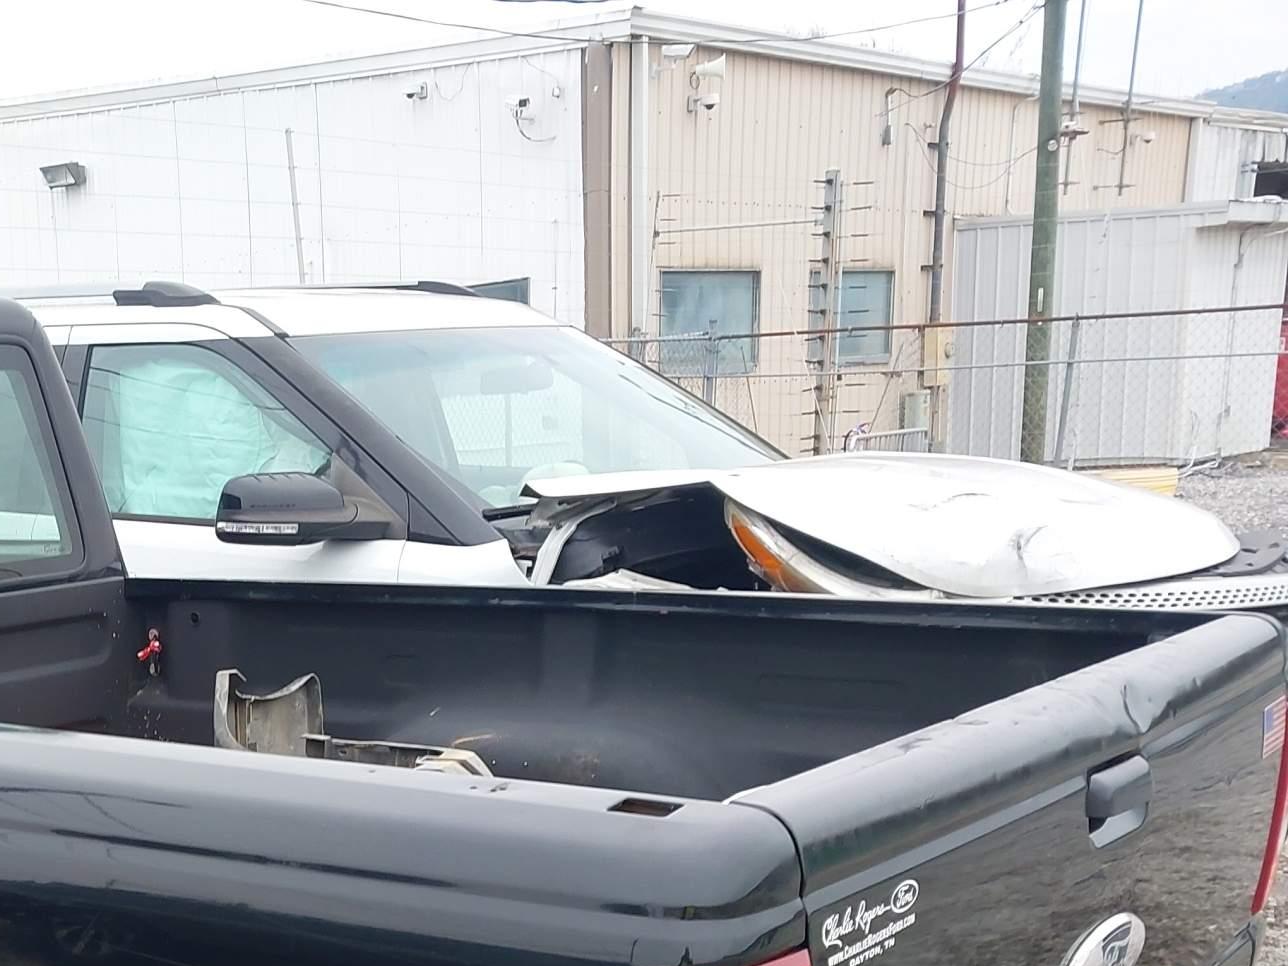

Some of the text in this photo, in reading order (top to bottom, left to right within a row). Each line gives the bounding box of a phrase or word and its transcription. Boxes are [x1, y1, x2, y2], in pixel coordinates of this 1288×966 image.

[896, 885, 914, 909] Ford
[822, 906, 854, 949] Charlie
[884, 938, 895, 950] TN
